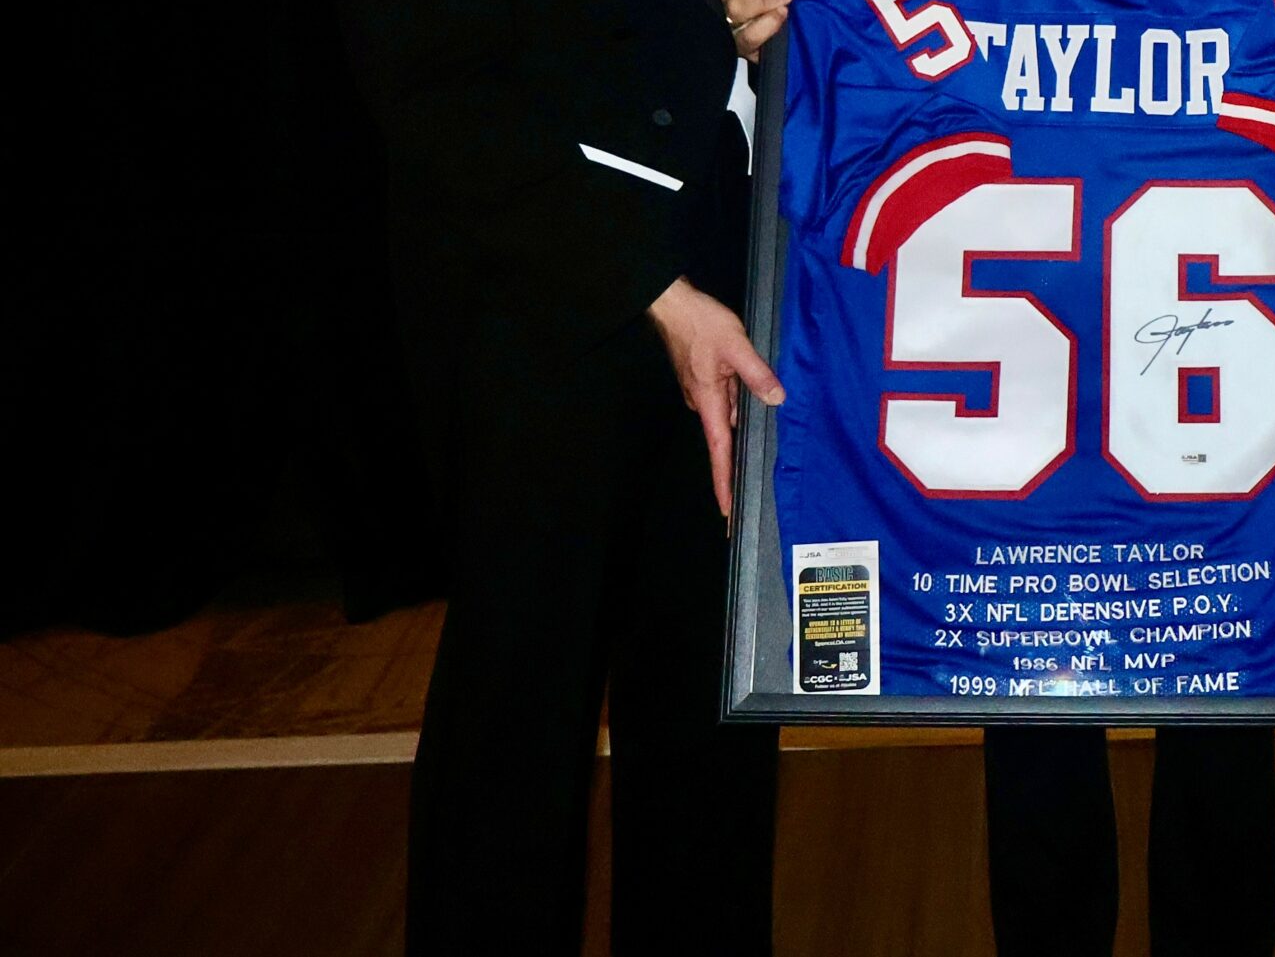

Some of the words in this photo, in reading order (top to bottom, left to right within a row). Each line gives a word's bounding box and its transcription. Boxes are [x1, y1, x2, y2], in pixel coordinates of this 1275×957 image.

[975, 545, 1102, 565] LAWRENCE
[1113, 543, 1204, 563] TAYLOR
[803, 582, 867, 593] CERTIFICATION
[912, 572, 932, 592] 10
[945, 574, 998, 594] TIME
[1010, 574, 1057, 594] PRO
[1069, 573, 1136, 592] BOWL
[1148, 561, 1270, 590] SELECTION
[945, 604, 974, 622] 3X
[987, 603, 1028, 622] NFL
[1040, 599, 1162, 622] DEFENSIVE
[1173, 594, 1239, 616] P.O.Y.
[934, 629, 963, 648] 2X
[976, 628, 1117, 647] SUPERBOWL
[1130, 620, 1251, 644] CHAMPION
[1013, 656, 1058, 671] 1986
[1071, 653, 1112, 671] NFL
[1124, 653, 1176, 670] MVP
[950, 675, 996, 696] 1999
[1009, 678, 1048, 696] NFL
[1063, 678, 1121, 696] HALL
[1134, 676, 1164, 695] OF
[1176, 672, 1239, 693] FAME
